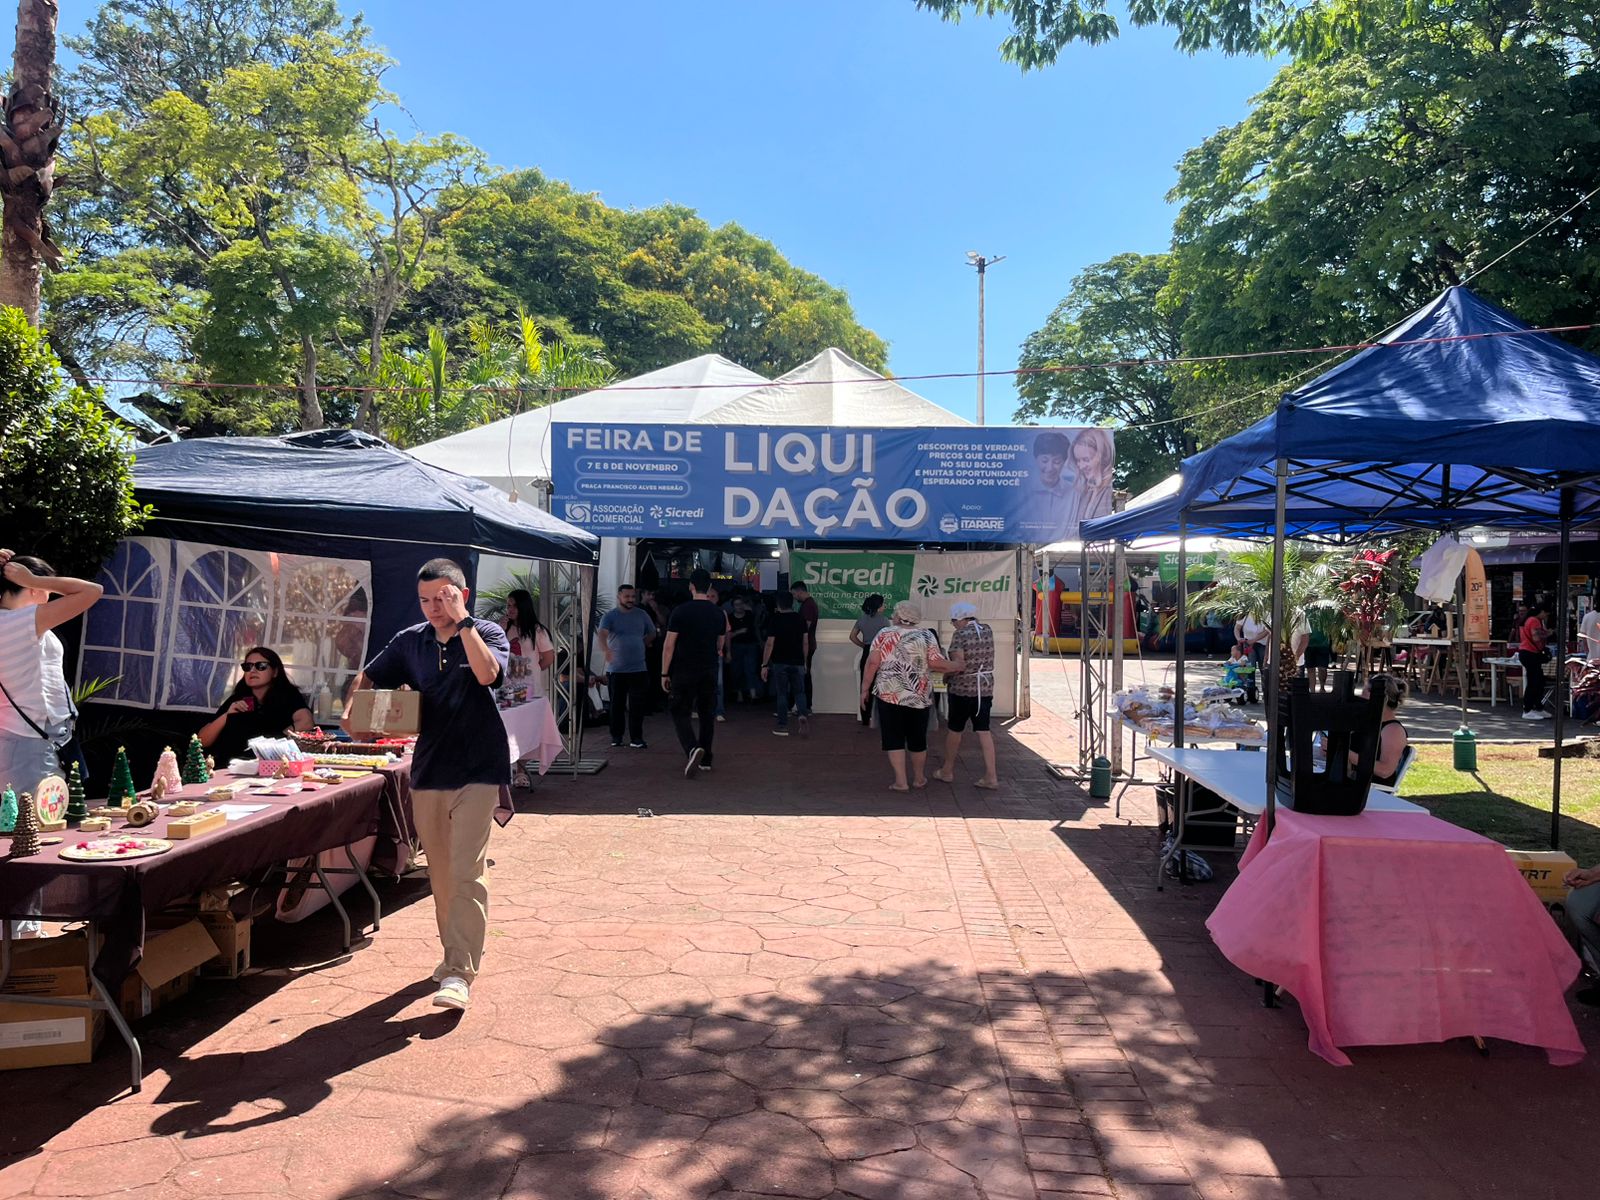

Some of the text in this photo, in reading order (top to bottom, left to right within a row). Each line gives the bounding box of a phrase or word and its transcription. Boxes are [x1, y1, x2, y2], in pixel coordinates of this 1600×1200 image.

[567, 428, 703, 453] FEIRA DE
[724, 431, 875, 474] LIQUI
[929, 453, 963, 461] PREÇOS
[625, 463, 679, 472] NOVEMBRO
[581, 483, 602, 491] PRAÇA
[997, 477, 1020, 486] VOCÊ
[592, 503, 645, 514] ASSOCIAÇÃO
[722, 477, 928, 536] DAÇÃO
[664, 507, 704, 518] Sicredi
[592, 514, 644, 524] COMERCIAL
[1164, 554, 1203, 565] Sicedi
[804, 561, 895, 586] Sicredi
[943, 575, 1011, 594] Sicredi
